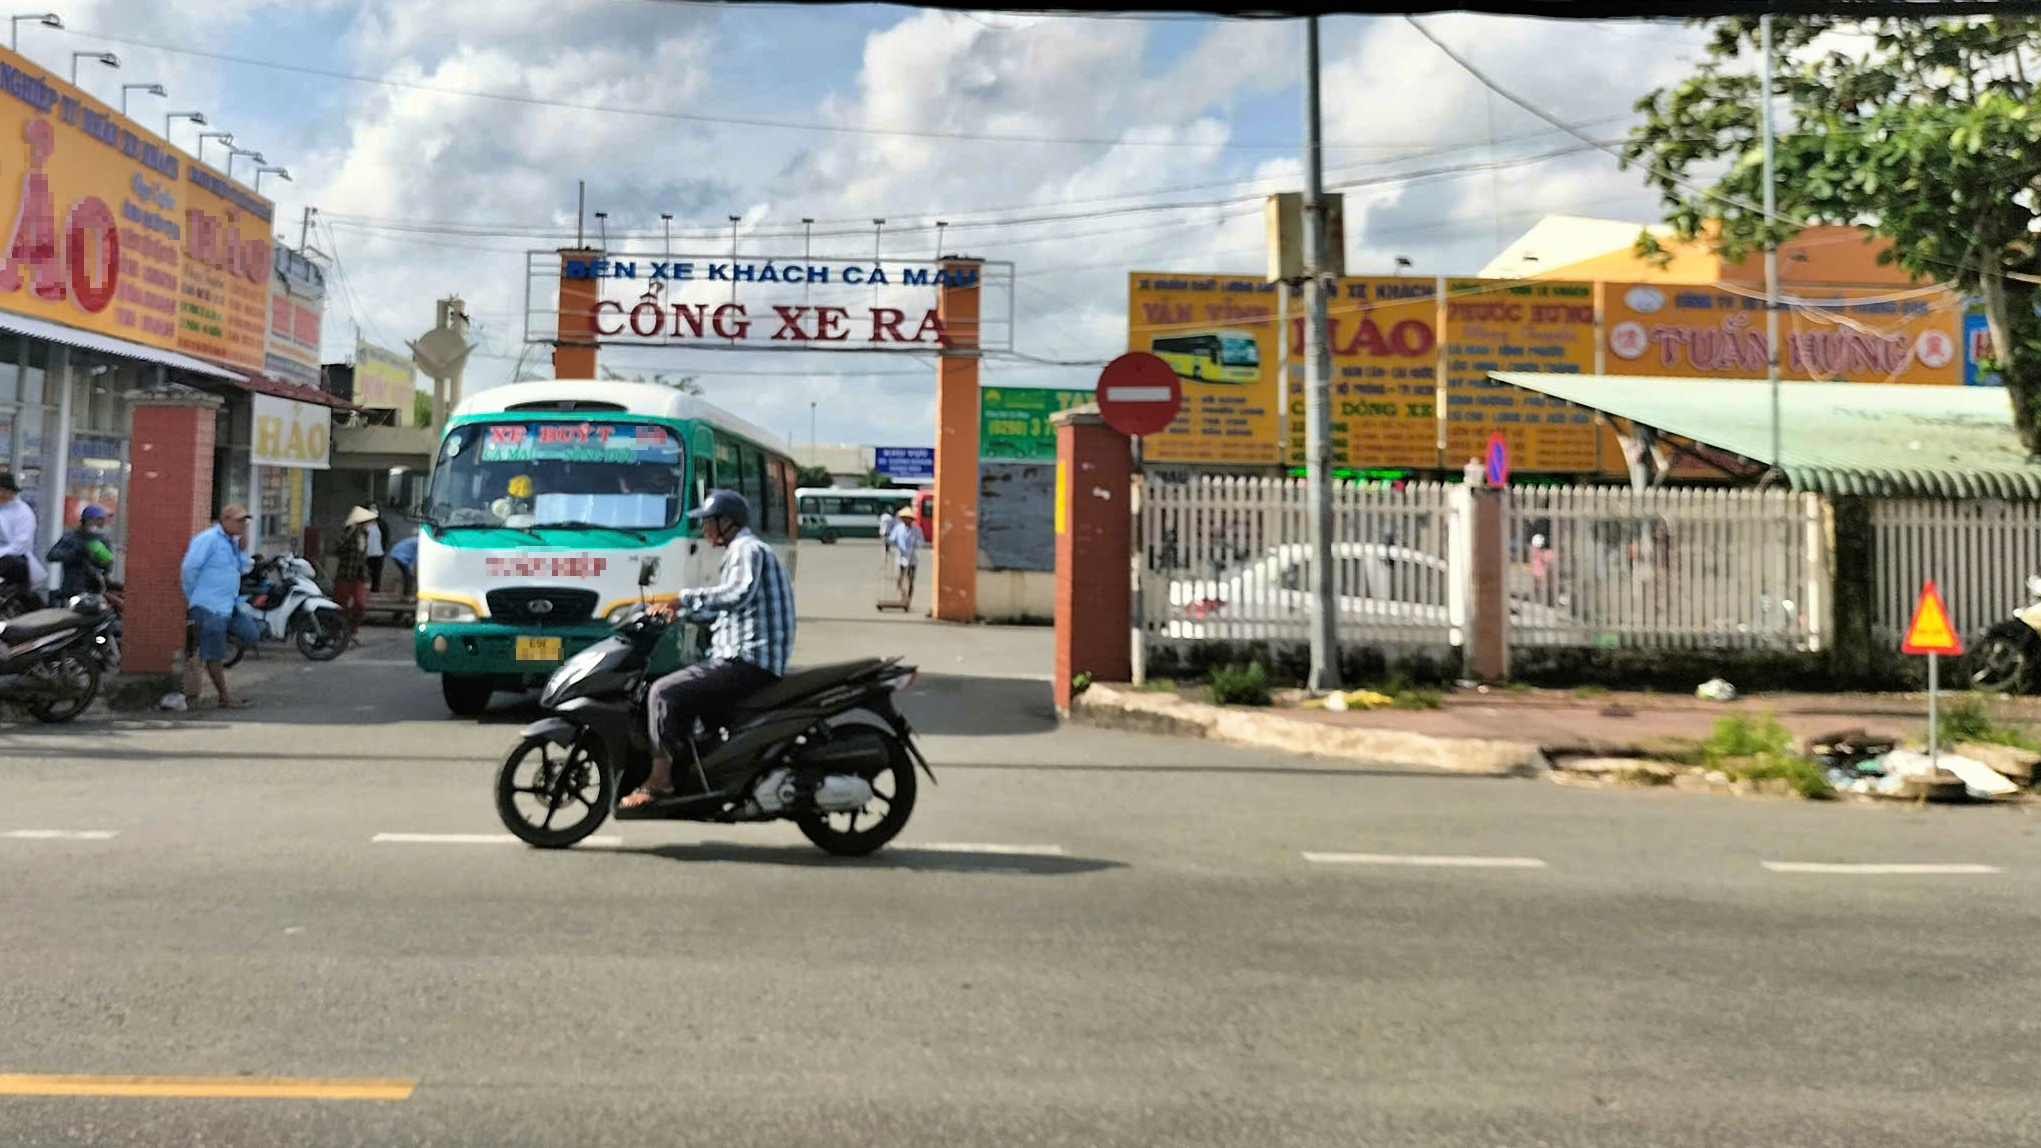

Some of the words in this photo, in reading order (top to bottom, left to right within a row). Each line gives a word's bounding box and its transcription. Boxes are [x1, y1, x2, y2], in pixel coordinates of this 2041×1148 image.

[650, 261, 695, 280] XE
[709, 258, 829, 284] KHÁCH
[903, 268, 978, 288] MAU
[589, 281, 752, 340] CỔNG
[771, 305, 851, 342] XE
[868, 307, 954, 346] RA
[489, 424, 528, 444] XE
